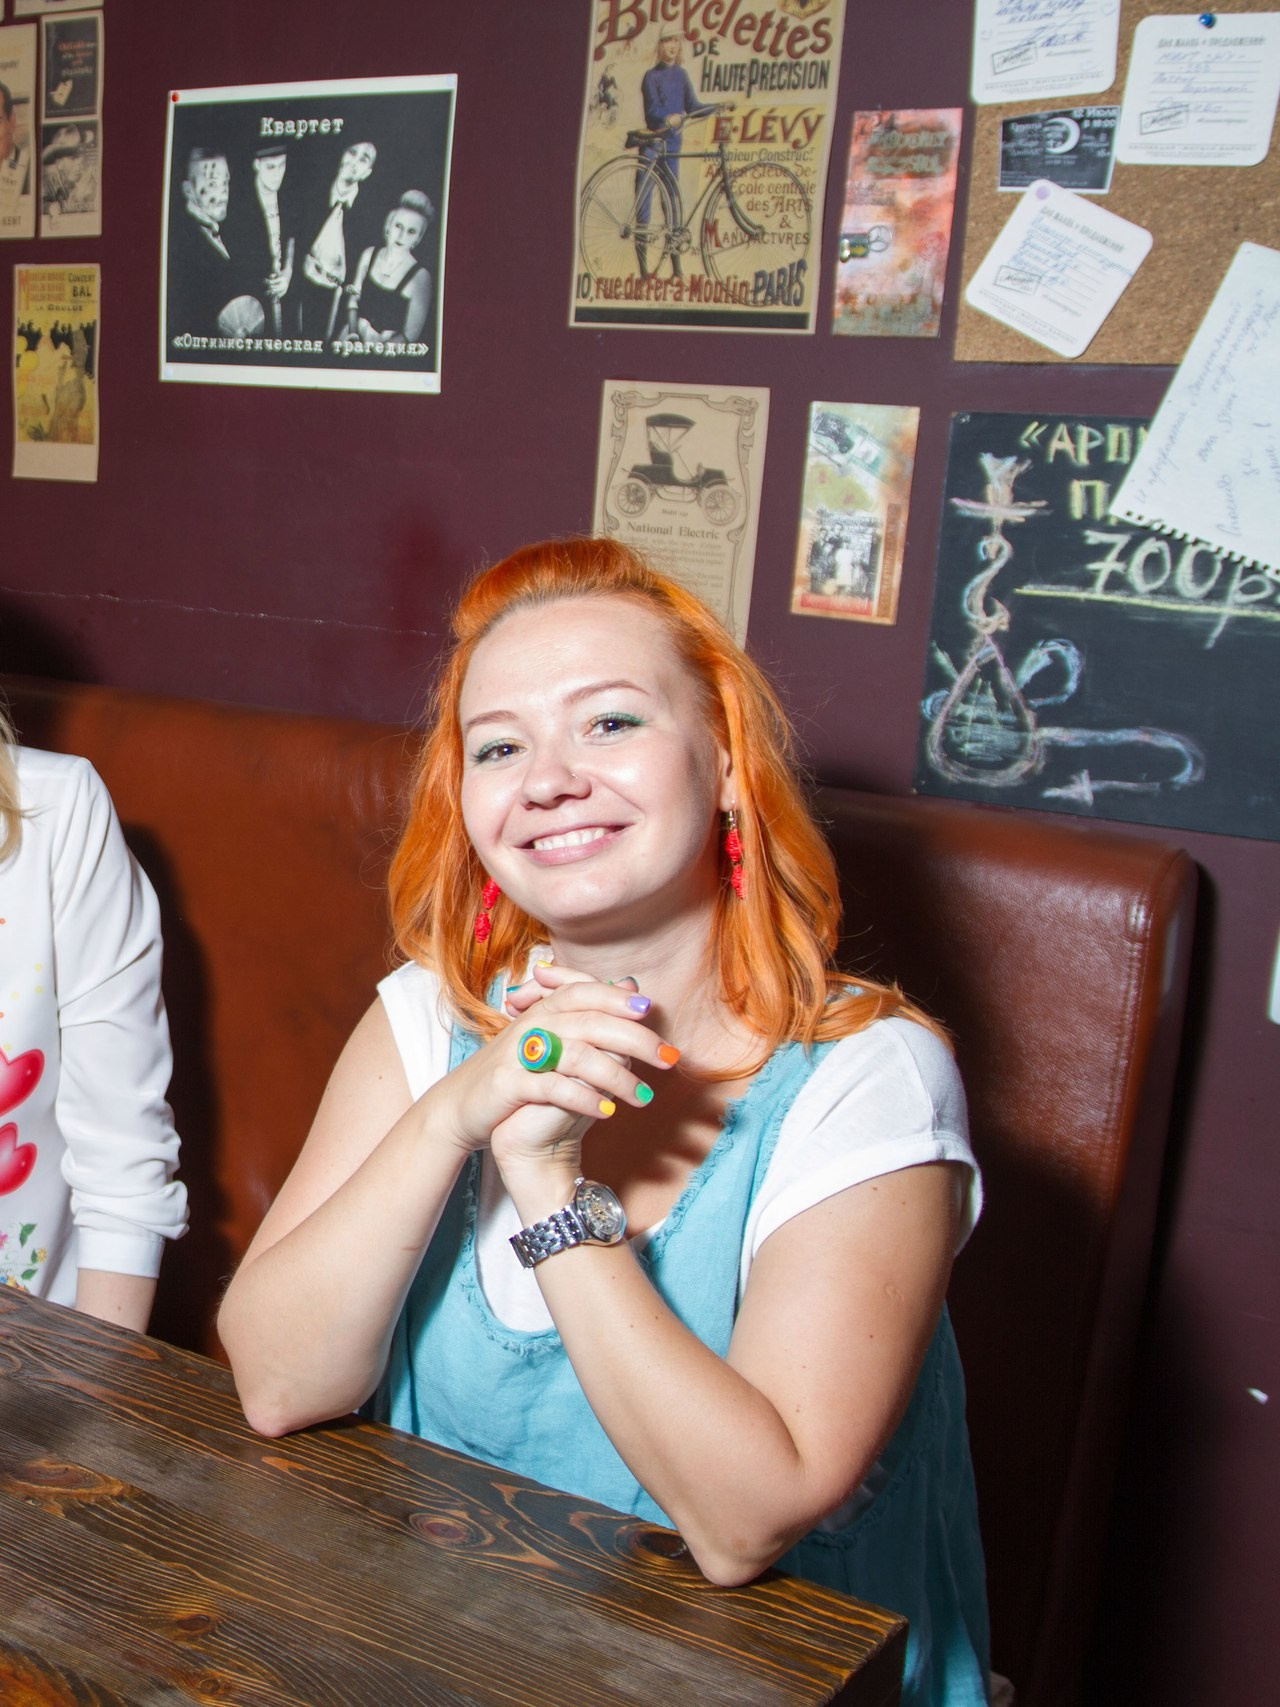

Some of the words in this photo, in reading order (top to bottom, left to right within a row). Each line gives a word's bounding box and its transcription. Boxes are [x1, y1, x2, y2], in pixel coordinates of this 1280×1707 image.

[693, 37, 720, 57] DE
[700, 56, 747, 92] HAUTE
[259, 116, 344, 138] Квартет
[72, 285, 92, 297] BAL
[173, 332, 324, 353] «Оптимистическая
[332, 340, 430, 357] трагедия»
[627, 521, 672, 537] National
[679, 526, 720, 540] Electric
